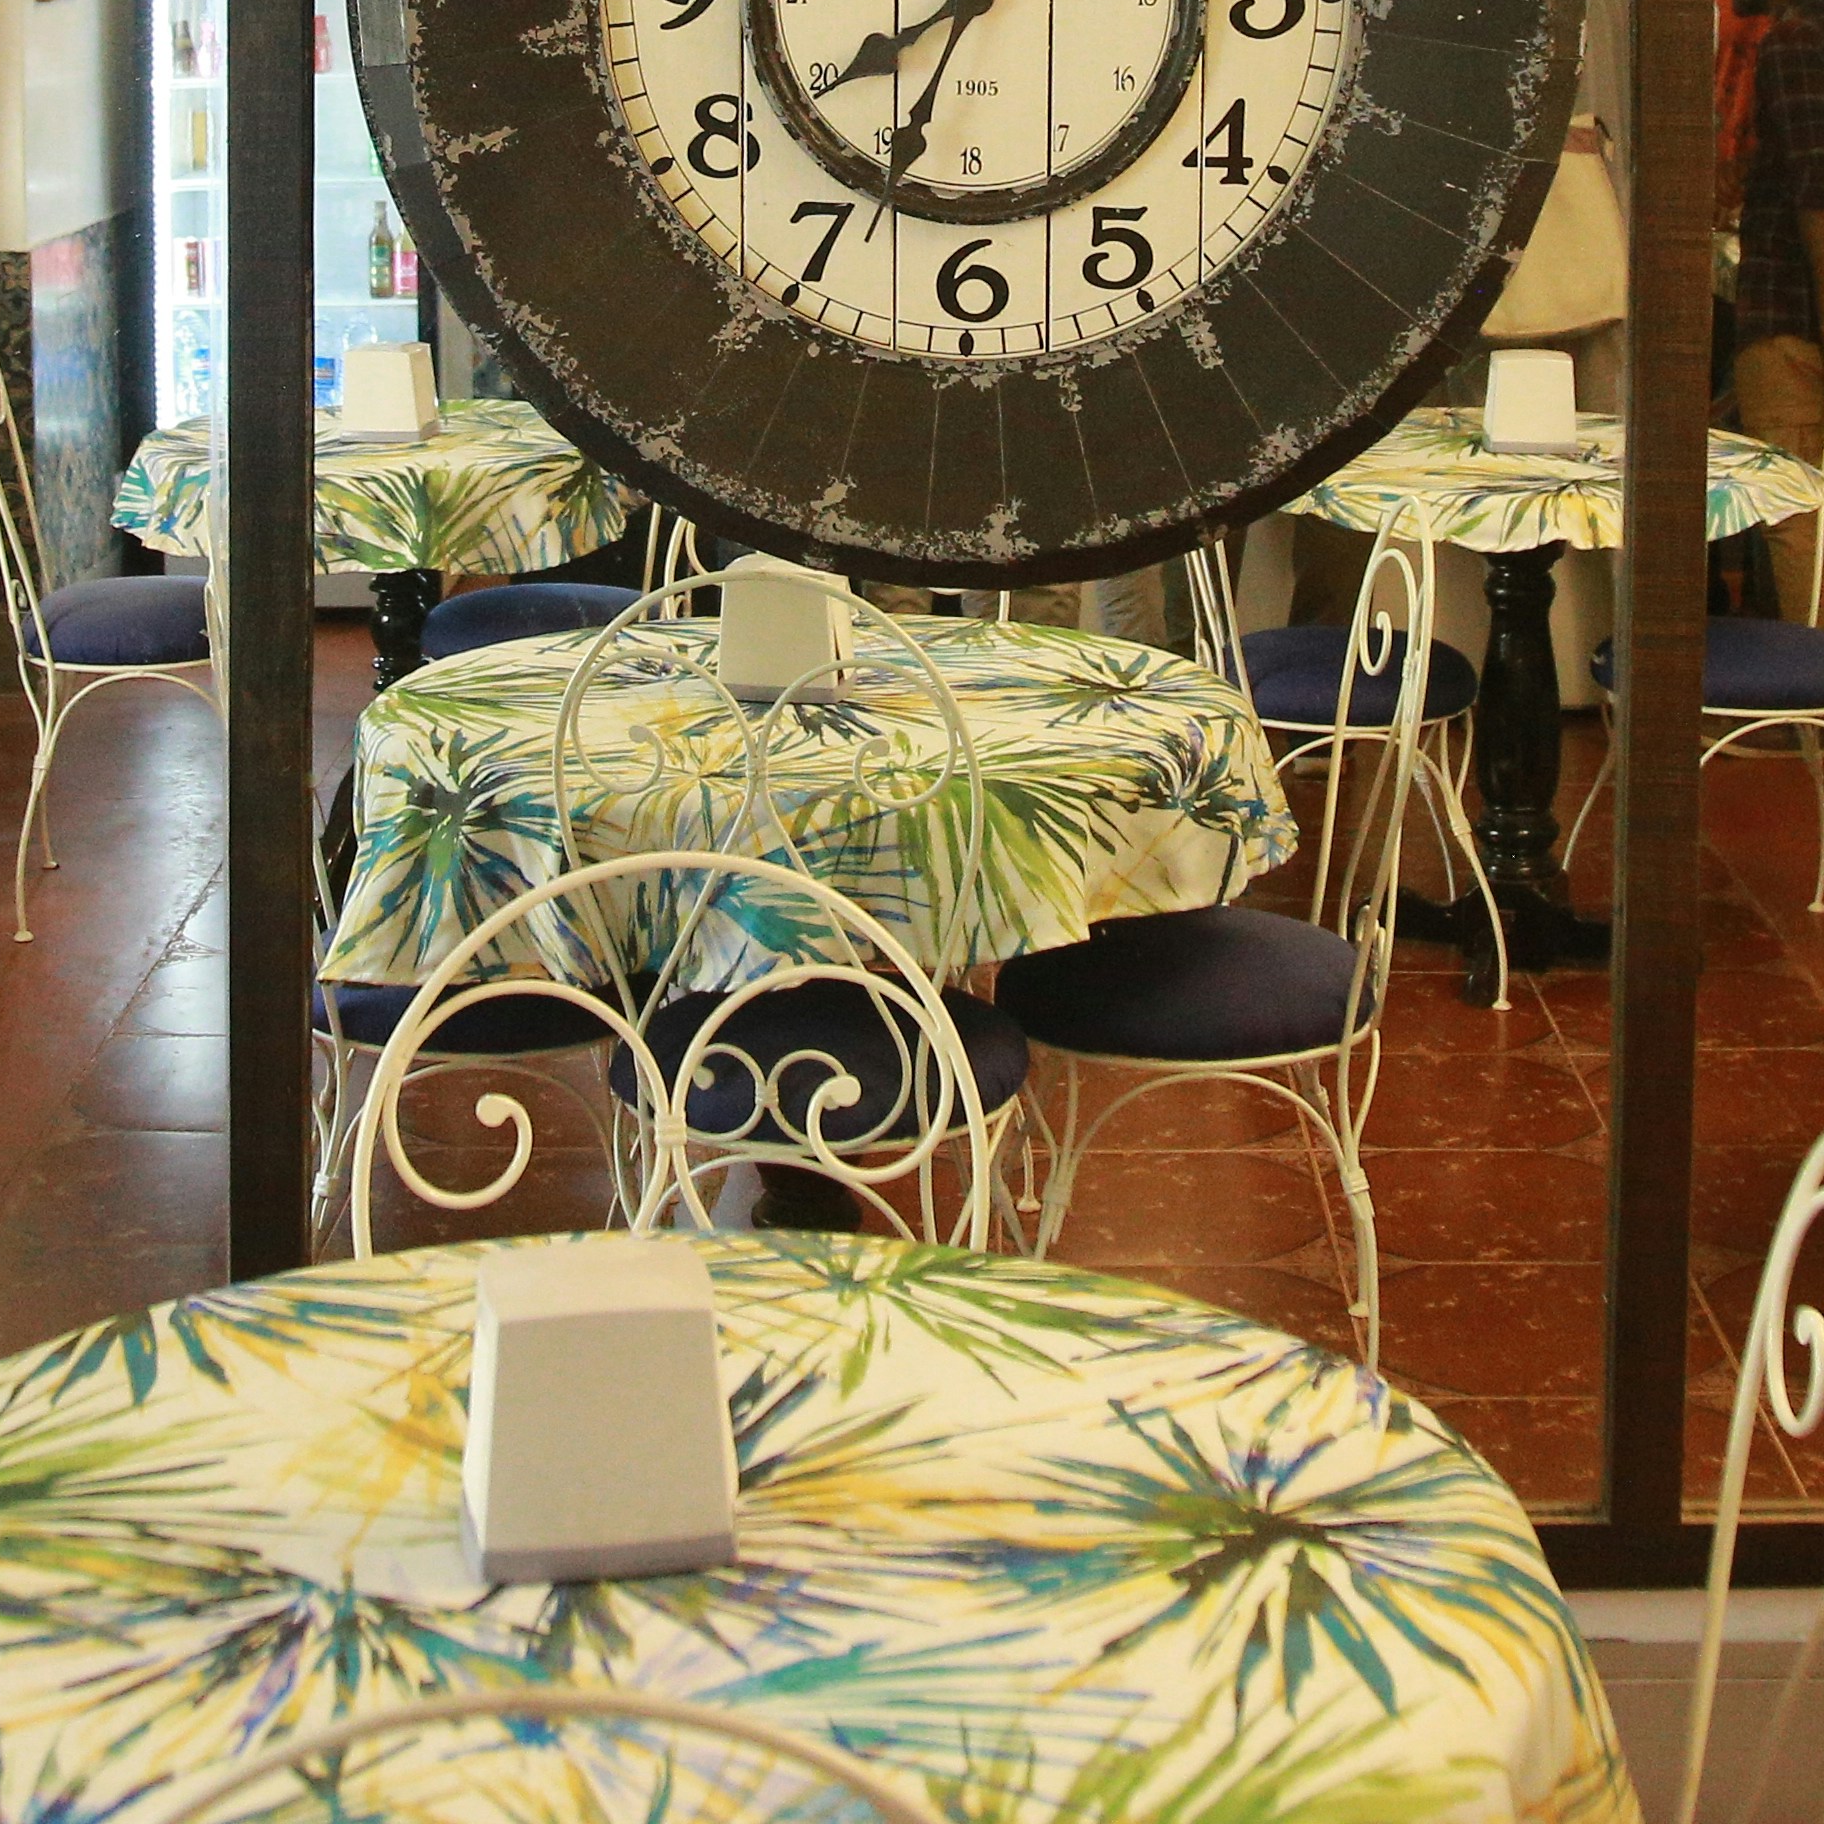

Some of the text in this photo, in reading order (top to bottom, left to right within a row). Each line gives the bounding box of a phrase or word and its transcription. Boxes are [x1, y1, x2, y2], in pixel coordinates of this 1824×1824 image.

[809, 62, 839, 92] 20
[955, 79, 999, 97] 1905
[1112, 65, 1136, 92] 16
[686, 92, 761, 180] 8
[959, 146, 983, 176] 18
[1182, 97, 1254, 187] 4
[789, 201, 856, 284] 7
[936, 238, 1010, 323] 6
[1082, 205, 1154, 291] 5
